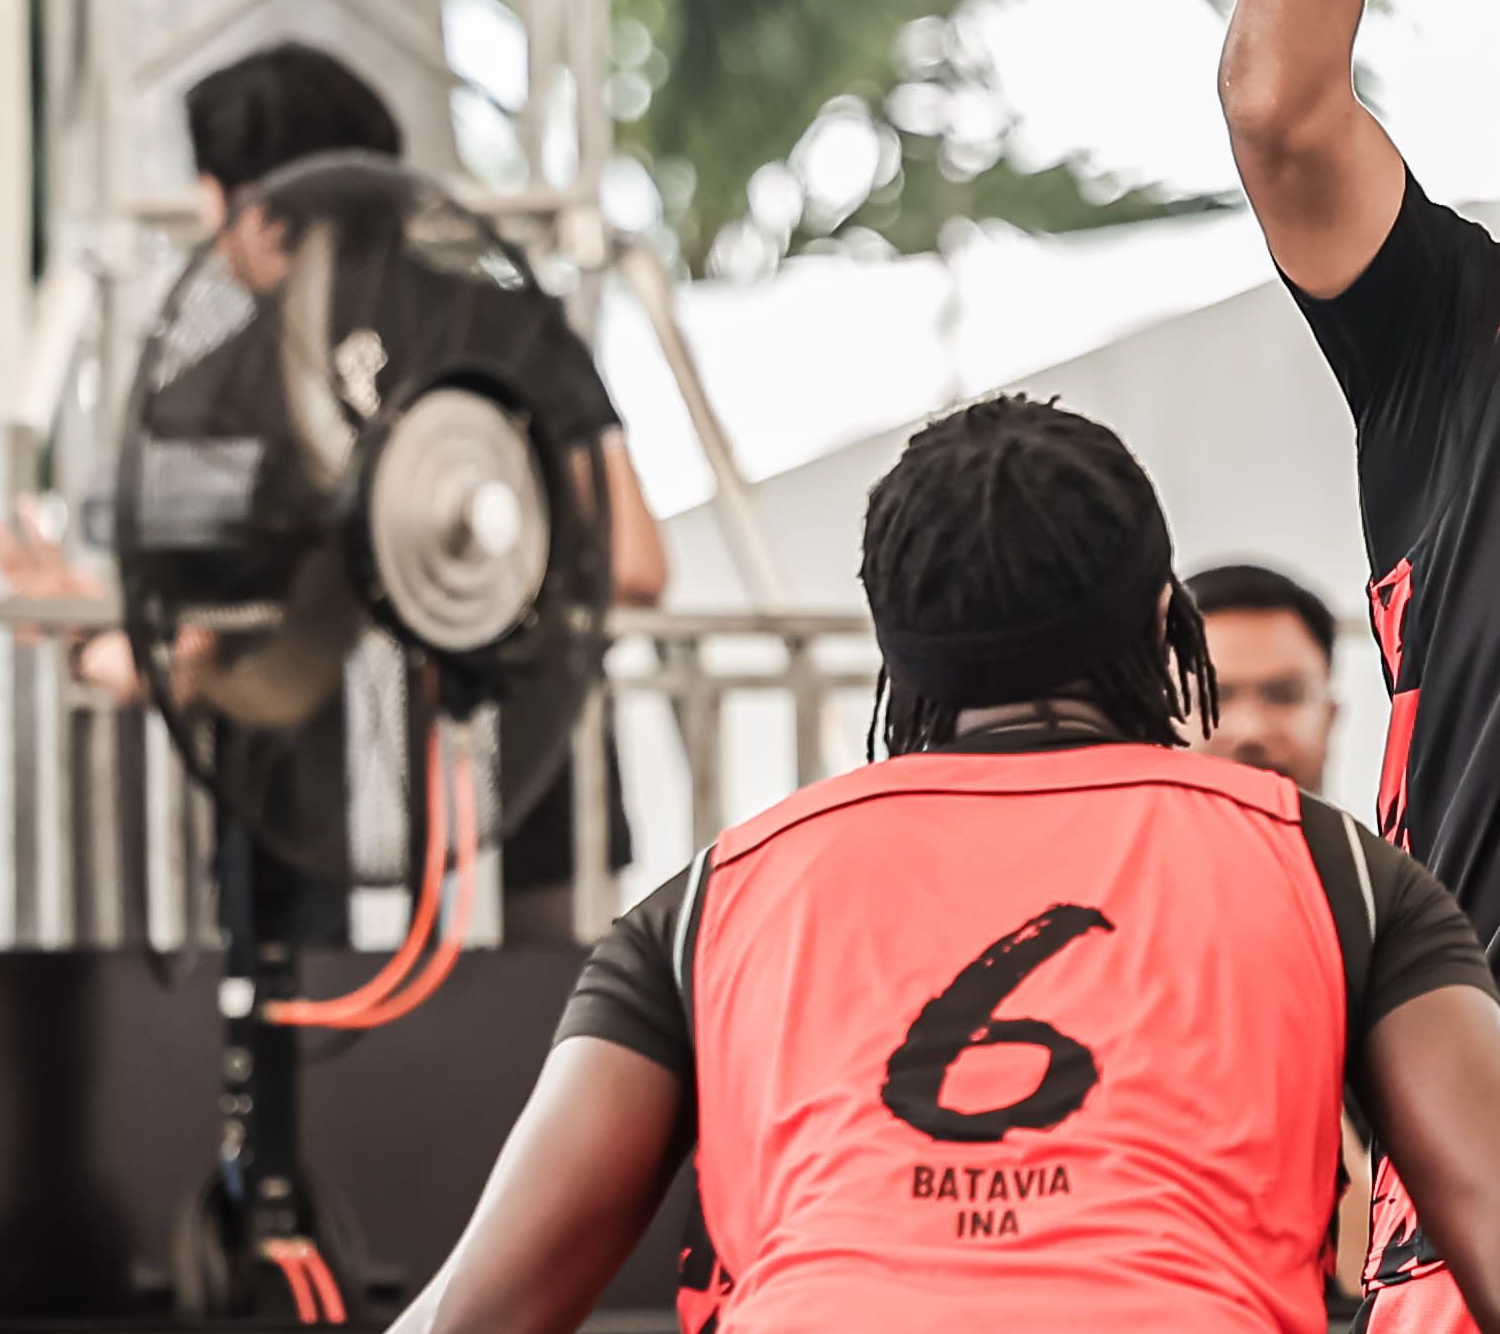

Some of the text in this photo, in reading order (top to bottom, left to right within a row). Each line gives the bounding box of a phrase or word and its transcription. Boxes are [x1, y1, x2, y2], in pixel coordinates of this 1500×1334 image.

[881, 903, 1116, 1142] 6
[912, 1164, 1070, 1200] BATAVIA
[956, 1210, 1020, 1238] INA
